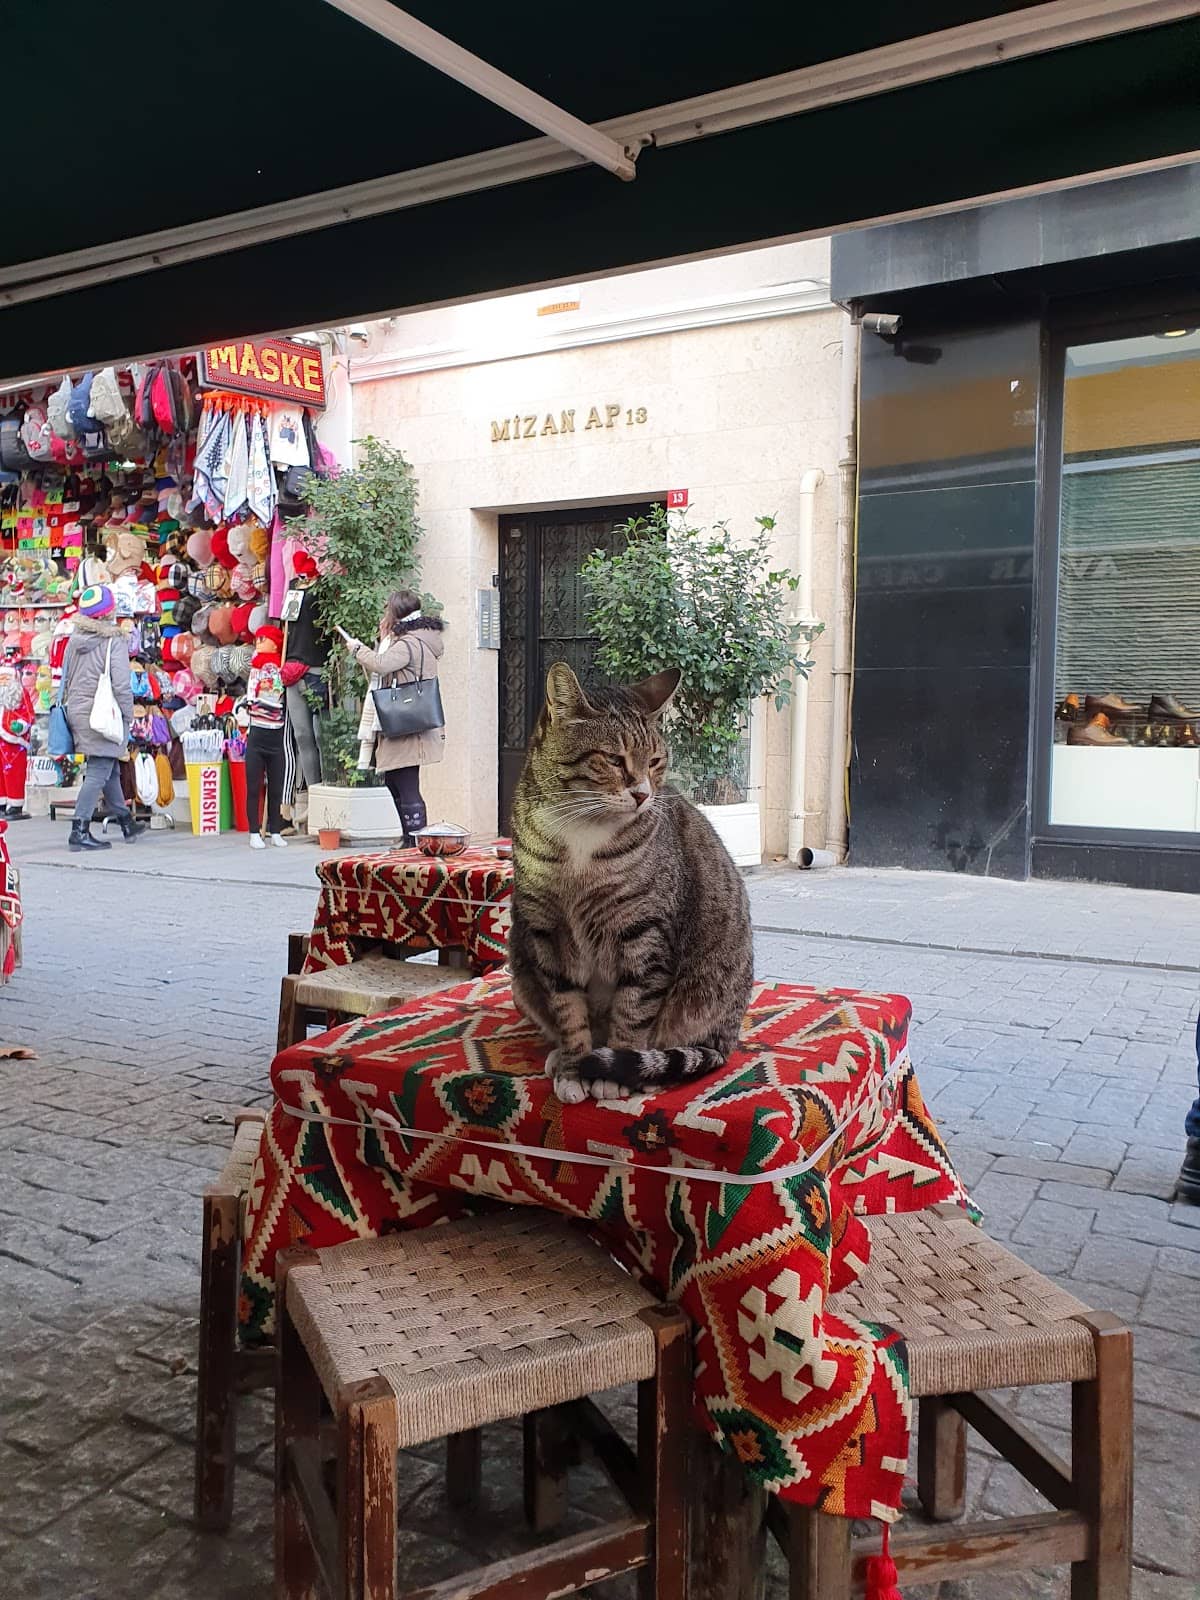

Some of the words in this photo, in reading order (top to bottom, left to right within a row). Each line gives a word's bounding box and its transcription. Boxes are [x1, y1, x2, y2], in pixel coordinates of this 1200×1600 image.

[209, 343, 321, 392] MASKE
[491, 409, 576, 442] MİZAN
[585, 404, 621, 430] AP
[626, 407, 648, 426] 13
[672, 492, 684, 504] 13
[201, 770, 219, 833] ŞEMSİYE
